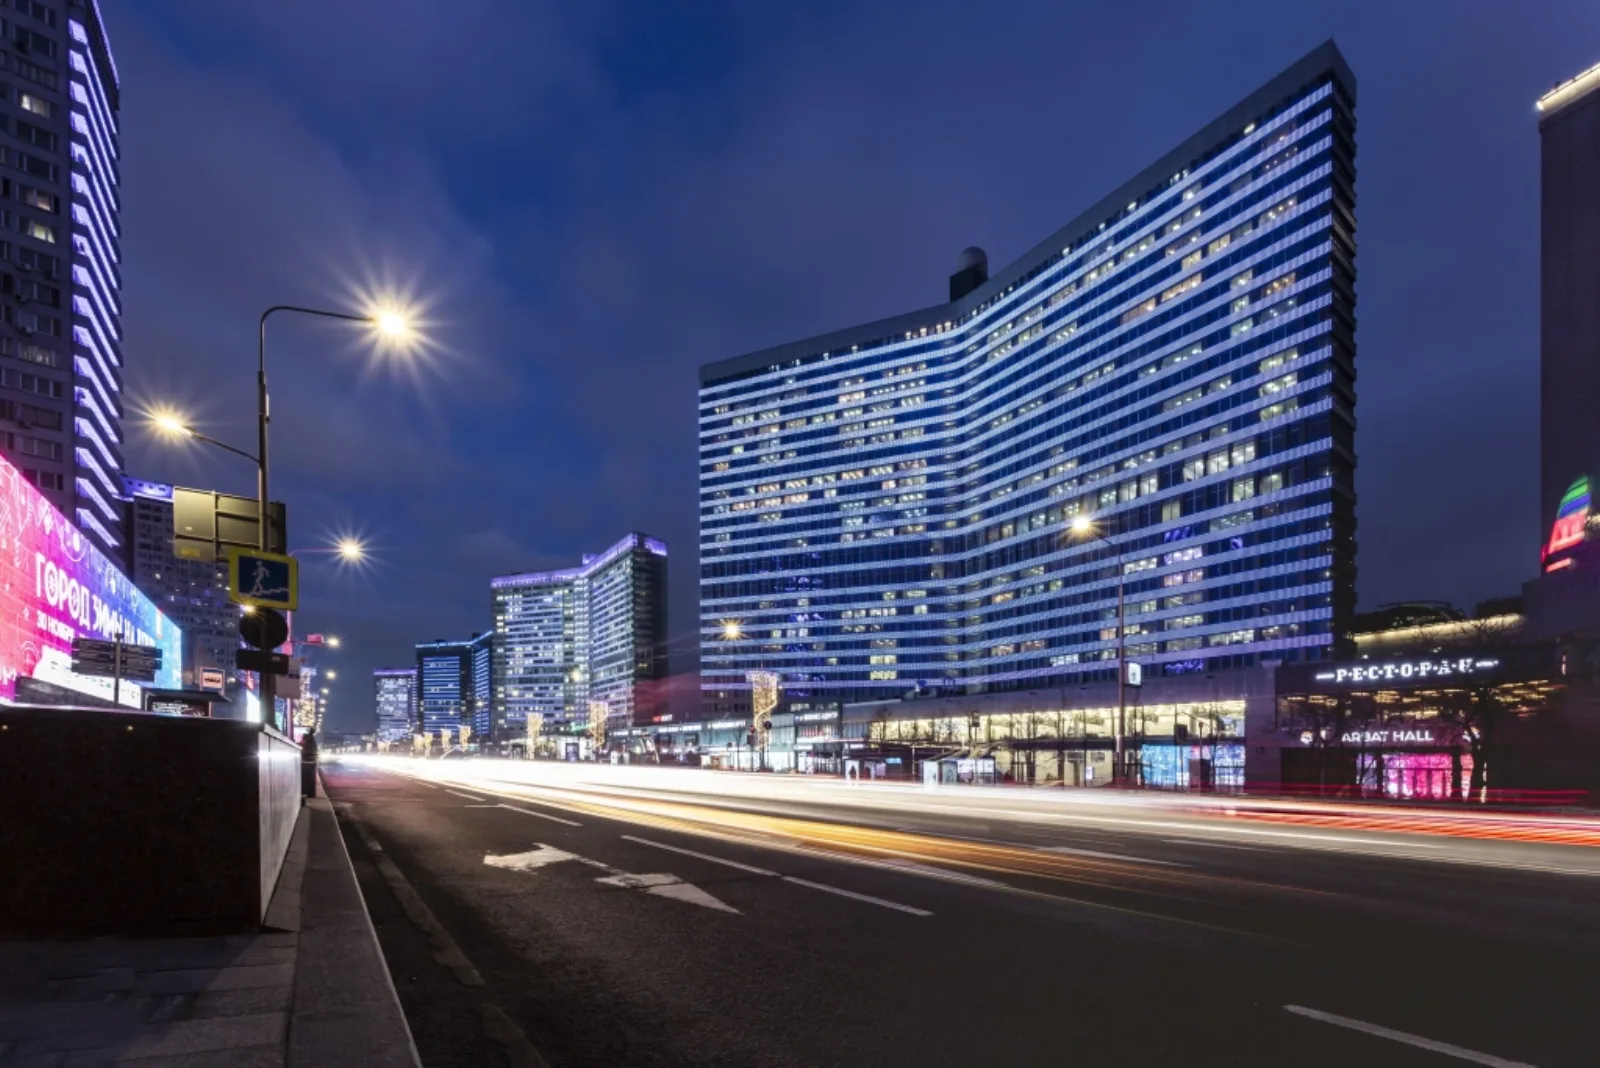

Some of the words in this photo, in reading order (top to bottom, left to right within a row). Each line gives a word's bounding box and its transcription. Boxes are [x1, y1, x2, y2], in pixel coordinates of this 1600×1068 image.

[34, 552, 90, 630] ГОРОД
[1341, 731, 1389, 742] ARBAT
[1391, 730, 1434, 742] HALL
